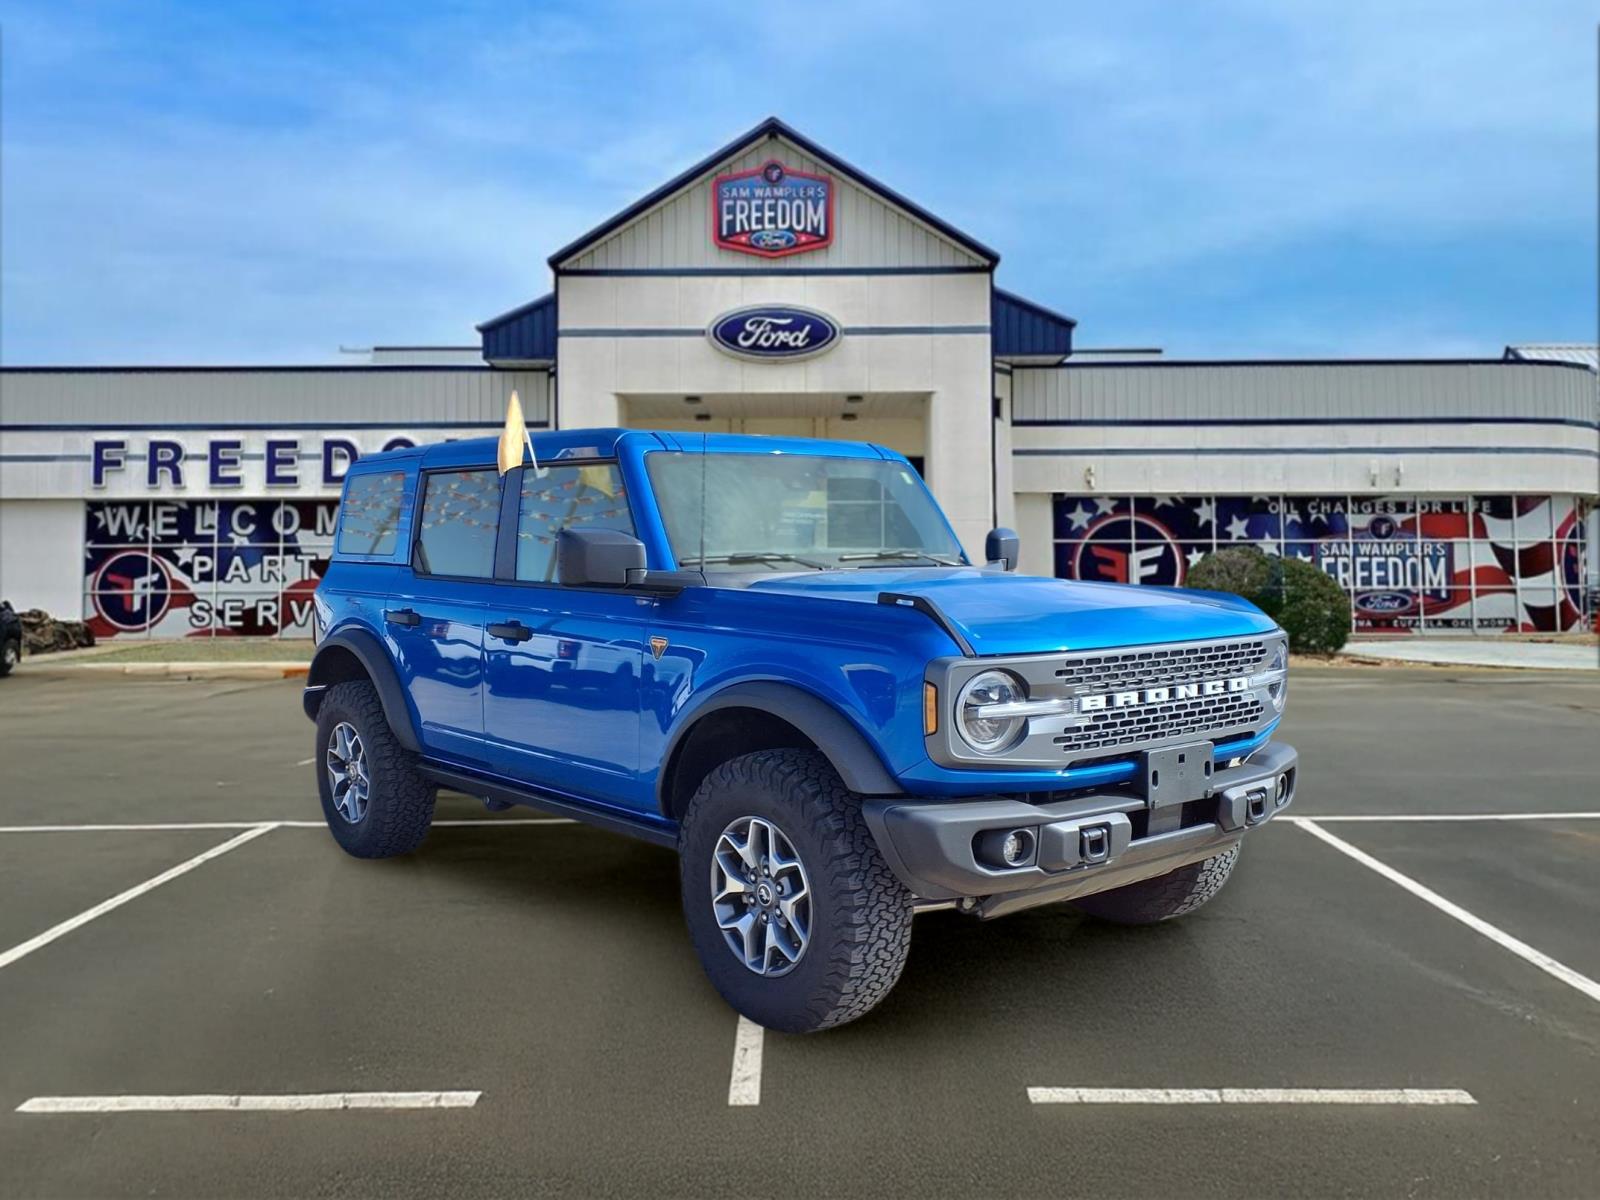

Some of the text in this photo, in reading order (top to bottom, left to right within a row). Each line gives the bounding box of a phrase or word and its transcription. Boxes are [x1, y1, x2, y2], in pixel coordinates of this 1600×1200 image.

[722, 187, 750, 198] SAM
[722, 200, 825, 236] FREEDOM
[760, 235, 787, 247] Ford
[738, 316, 811, 348] Ford
[1268, 502, 1298, 514] OIL
[1307, 501, 1397, 514] CHANGES
[1405, 501, 1442, 513] FOR
[1321, 557, 1447, 598] FREEDOM
[1081, 677, 1248, 711] BRONCO
